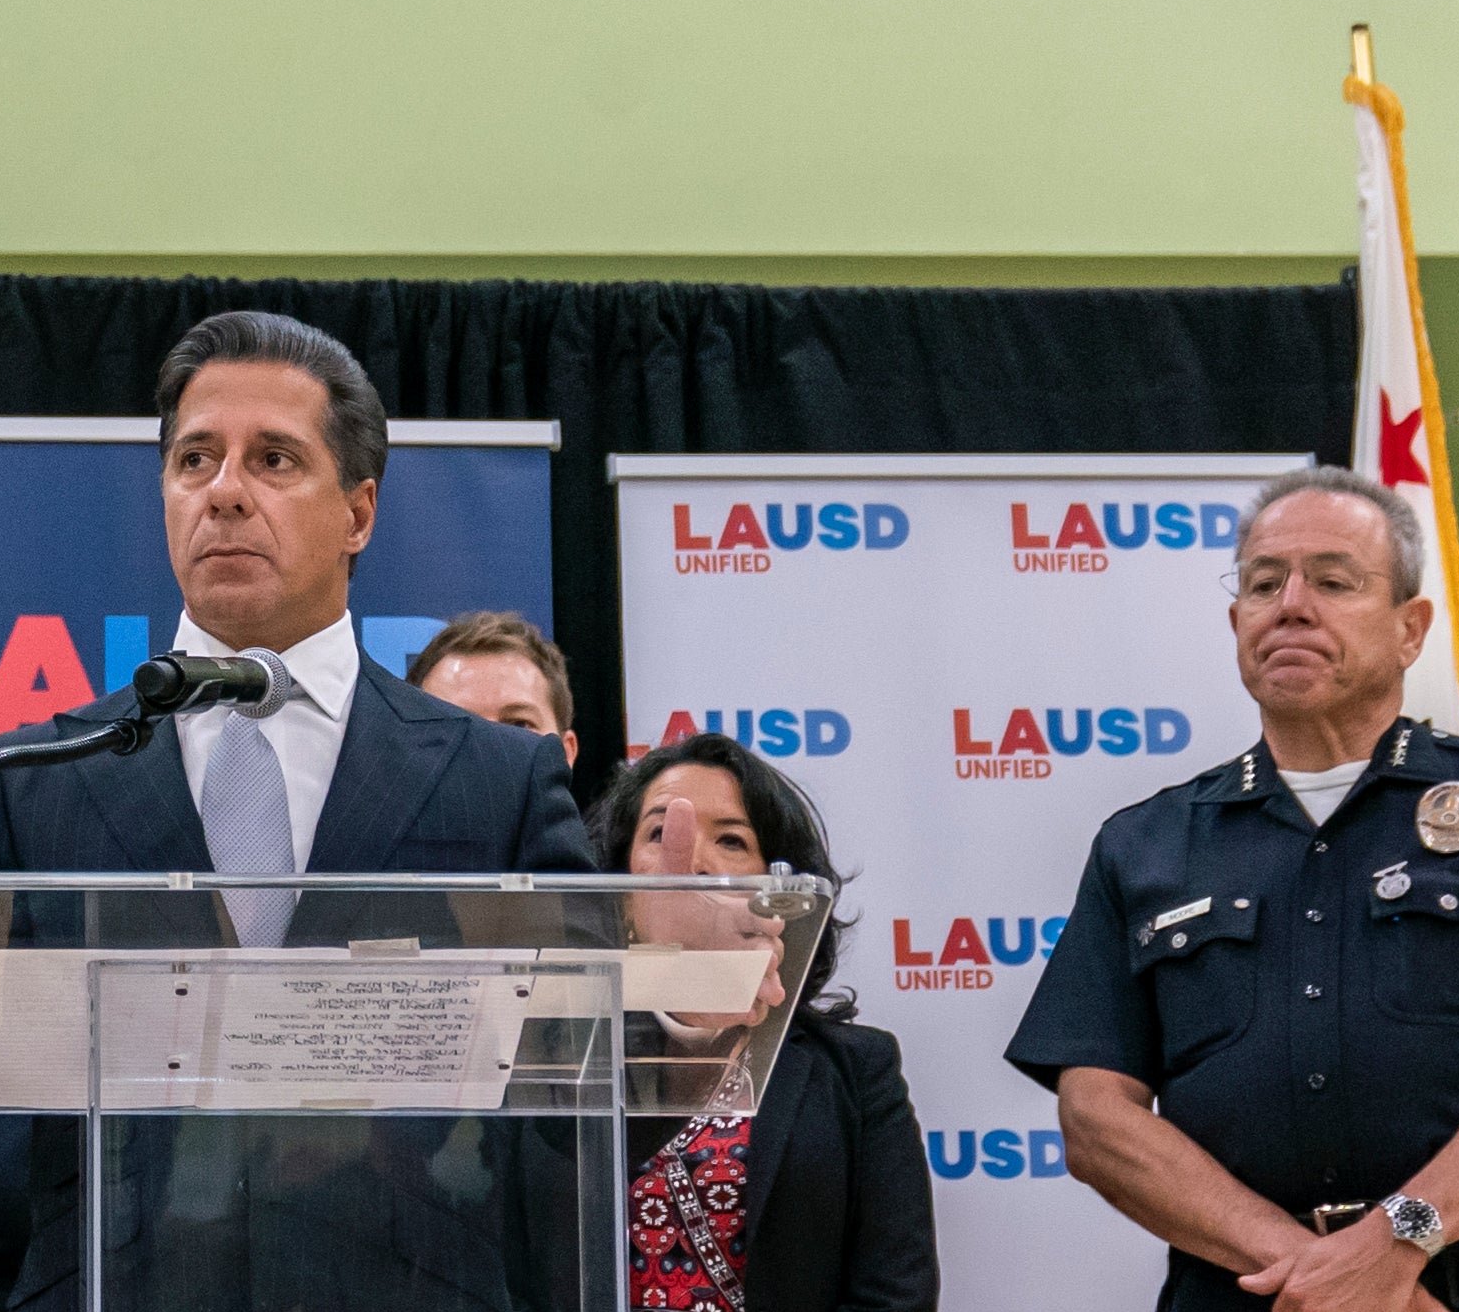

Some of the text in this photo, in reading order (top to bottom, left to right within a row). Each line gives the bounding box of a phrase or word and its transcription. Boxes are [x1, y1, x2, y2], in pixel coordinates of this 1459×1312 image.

[673, 502, 911, 551] LAUSD
[1011, 502, 1240, 551] LAUSD
[675, 554, 772, 574] UNIFIED
[1013, 553, 1108, 573] UNIFIED
[953, 707, 1192, 757] LAUSD
[955, 758, 1052, 779] UNIFIED
[894, 970, 993, 991] UNIFIED
[928, 1129, 1069, 1180] USD
